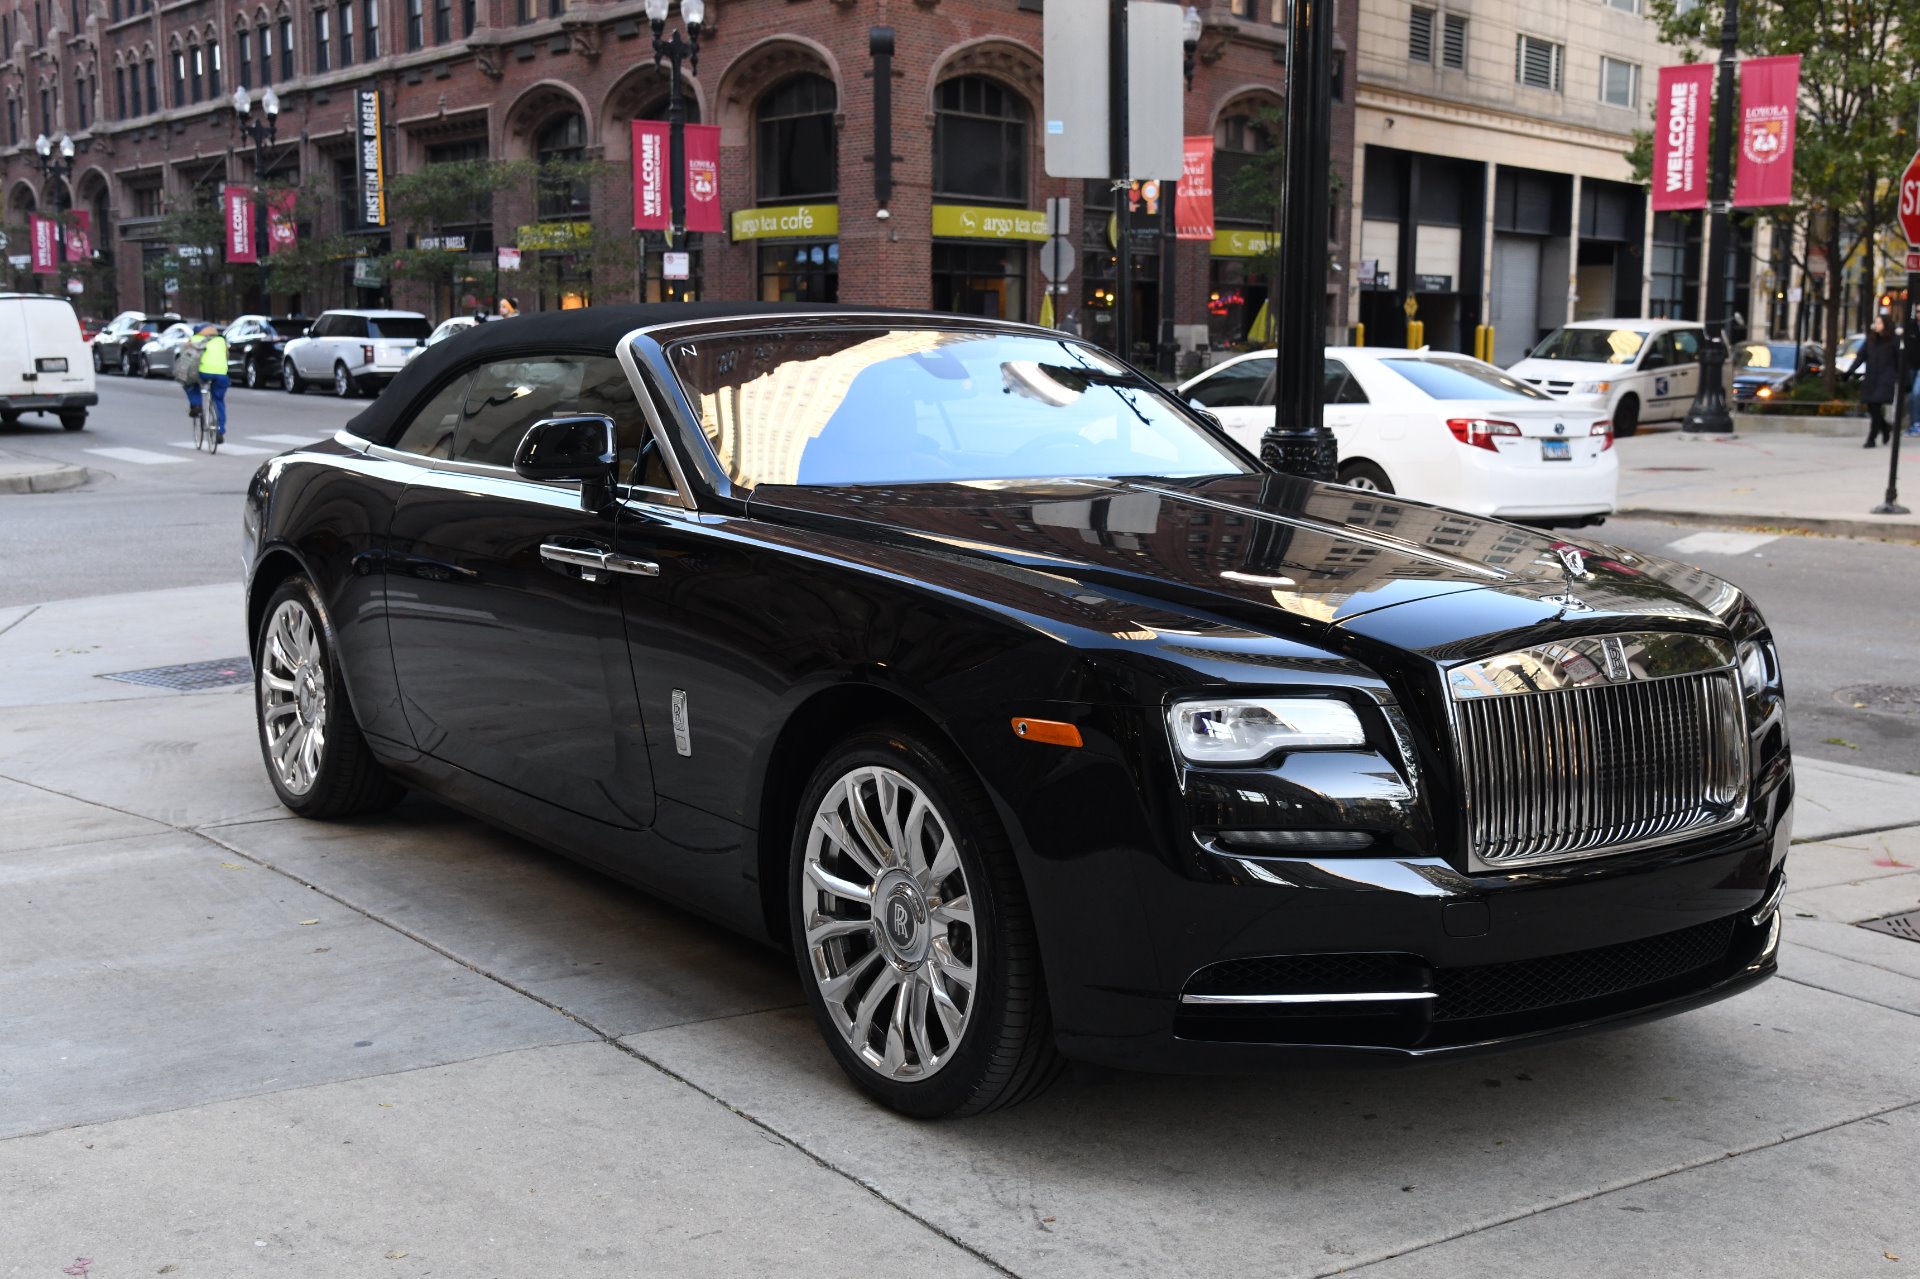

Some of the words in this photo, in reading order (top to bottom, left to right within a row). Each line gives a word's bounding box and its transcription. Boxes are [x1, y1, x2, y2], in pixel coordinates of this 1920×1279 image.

[361, 91, 377, 136] BAGELS
[1687, 82, 1699, 124] CAMPUS
[1745, 105, 1789, 118] LOYOLA
[1666, 82, 1688, 192] WELCOME
[1685, 124, 1696, 159] TOWER
[641, 133, 655, 216] WELCOME
[1683, 159, 1694, 192] WATER
[365, 172, 380, 224] EINSTEIN
[761, 215, 777, 232] tea
[780, 206, 814, 230] café
[231, 196, 244, 254] WELCOME
[982, 216, 1013, 237] argo
[1015, 217, 1031, 233] tea
